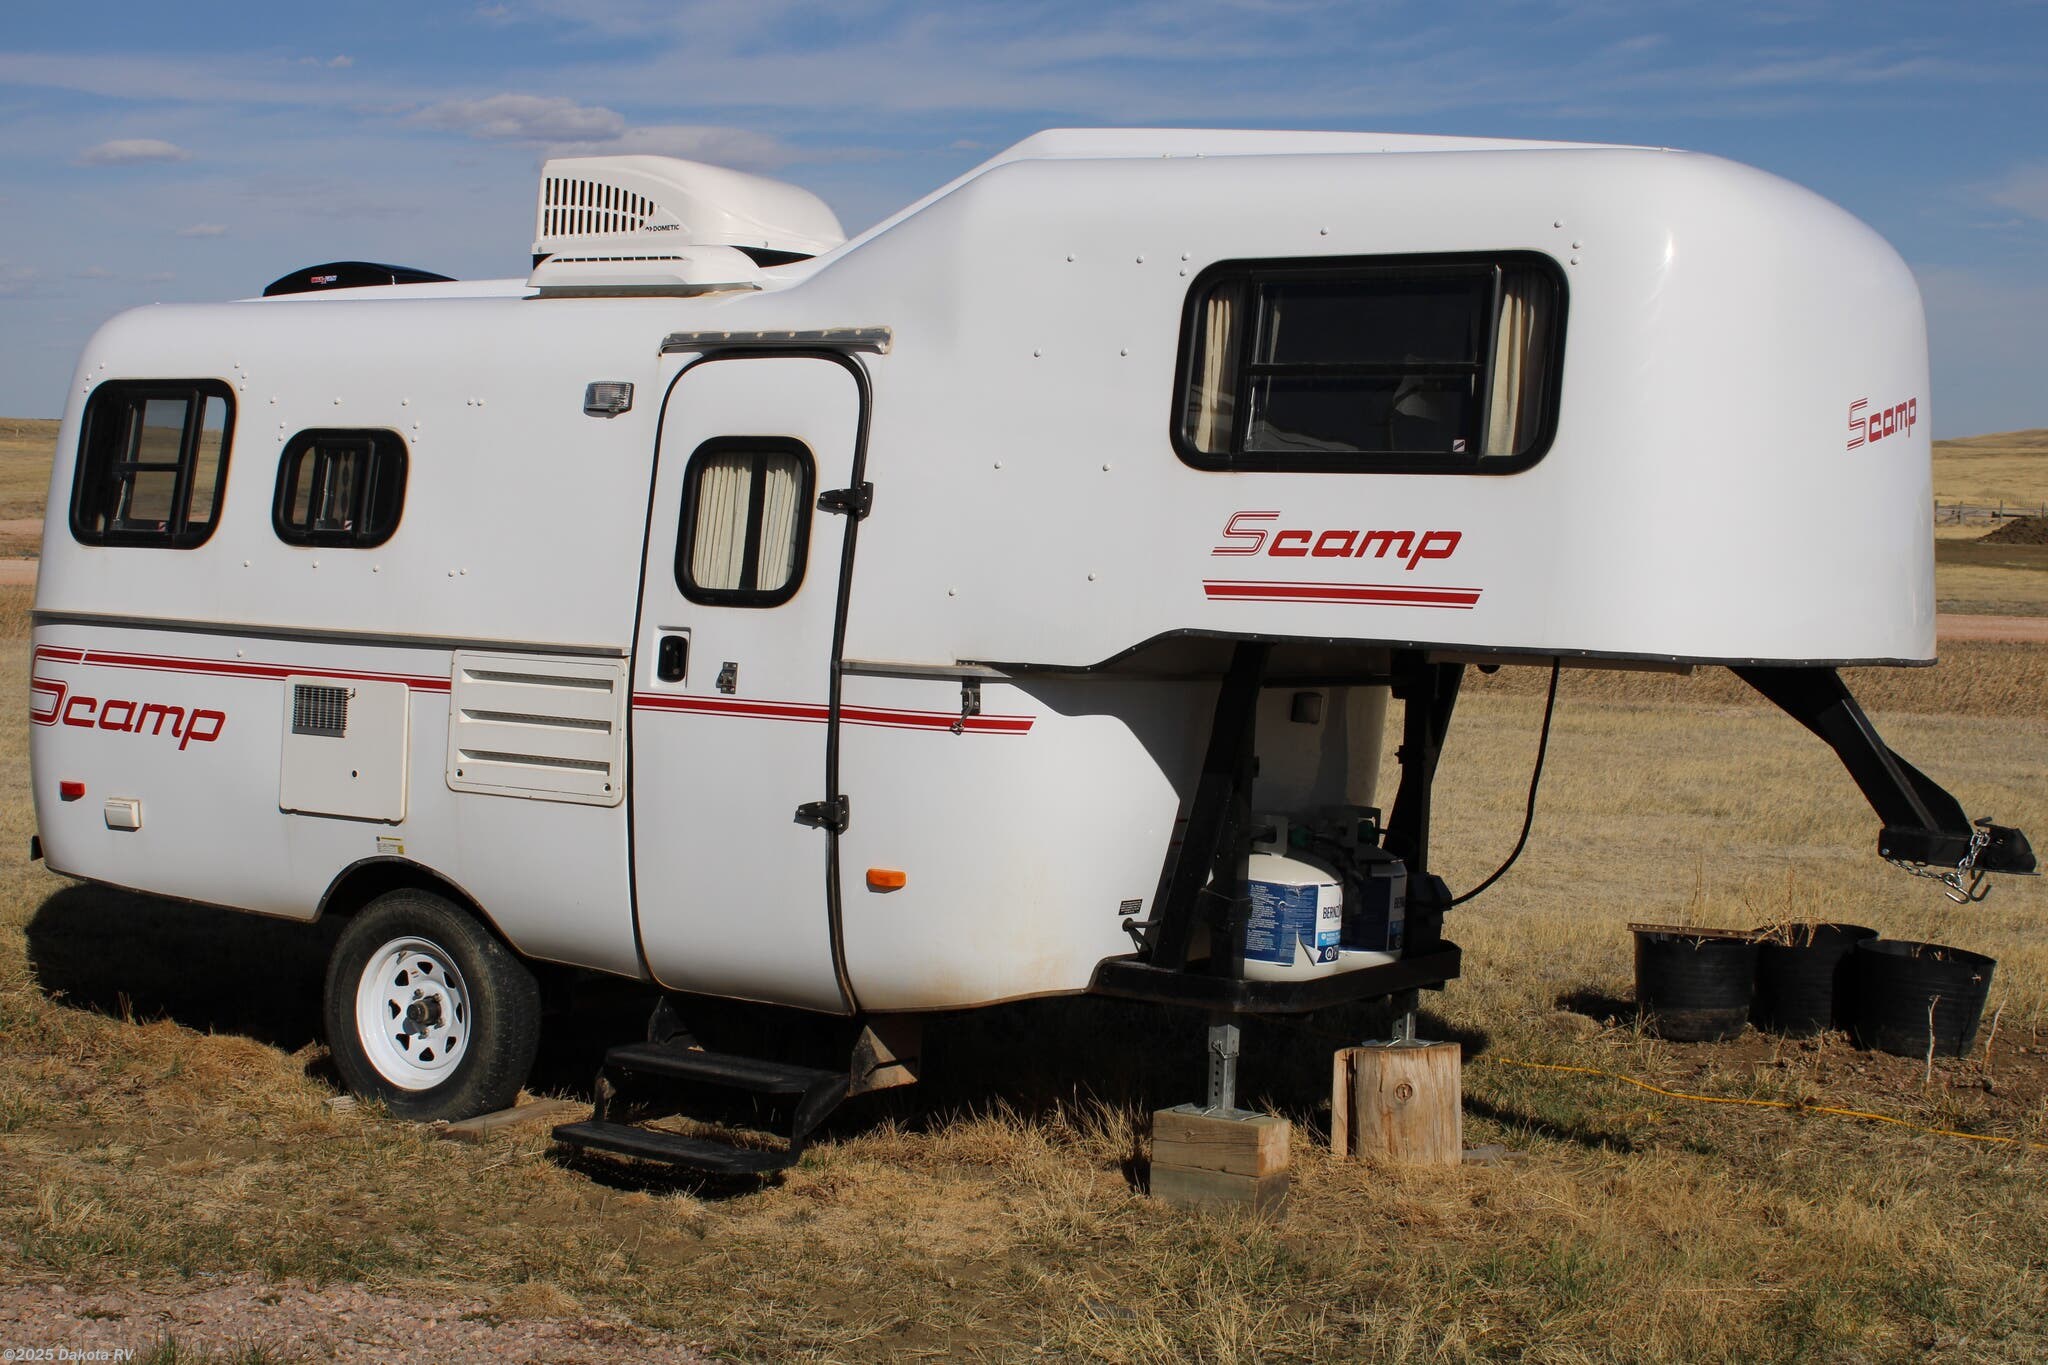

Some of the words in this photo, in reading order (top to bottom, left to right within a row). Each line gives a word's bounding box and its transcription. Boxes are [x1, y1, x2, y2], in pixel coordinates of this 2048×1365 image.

[1846, 397, 1917, 450] Scamp
[1210, 510, 1463, 570] Scamp
[31, 644, 226, 751] Scamp
